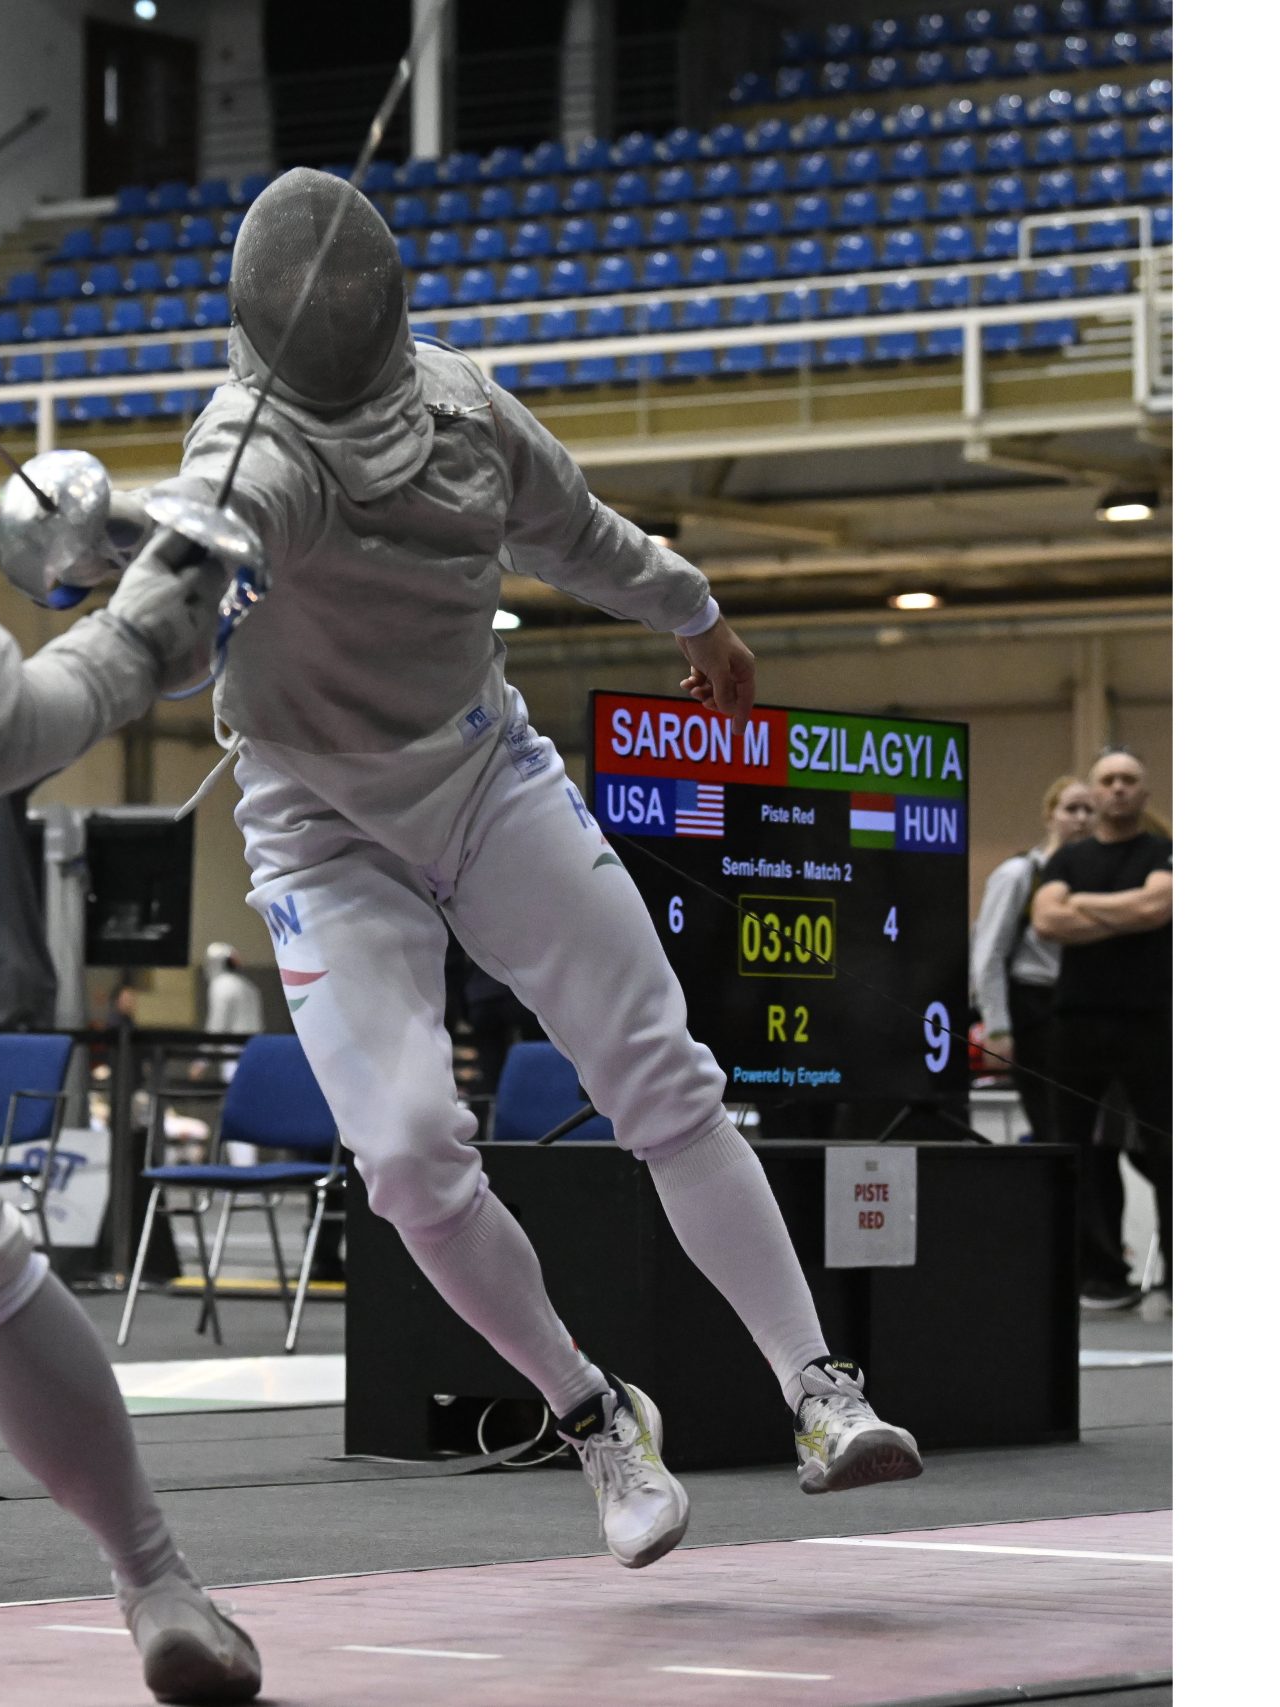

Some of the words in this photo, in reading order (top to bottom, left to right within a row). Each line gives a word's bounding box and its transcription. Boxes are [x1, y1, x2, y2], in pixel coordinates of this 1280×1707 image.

[611, 708, 733, 766] SARON
[743, 720, 770, 767] M
[788, 723, 933, 779] SZILAGYI
[941, 736, 963, 782] A
[607, 784, 666, 826] USA
[761, 804, 790, 823] Piste
[792, 806, 815, 825] Red
[904, 805, 958, 845] HUN
[721, 856, 792, 879] Semi-finals
[803, 861, 841, 881] Match
[842, 865, 853, 882] 2
[668, 896, 684, 934] 6
[883, 906, 900, 943] 4
[741, 910, 834, 966] 03:00
[768, 1004, 785, 1042] R
[793, 1005, 809, 1043] 2
[923, 1000, 952, 1073] 9
[733, 1066, 781, 1083] Powered
[783, 1070, 795, 1086] by
[796, 1069, 841, 1087] Engarde
[854, 1183, 890, 1202] PISTE
[858, 1210, 885, 1230] RED
